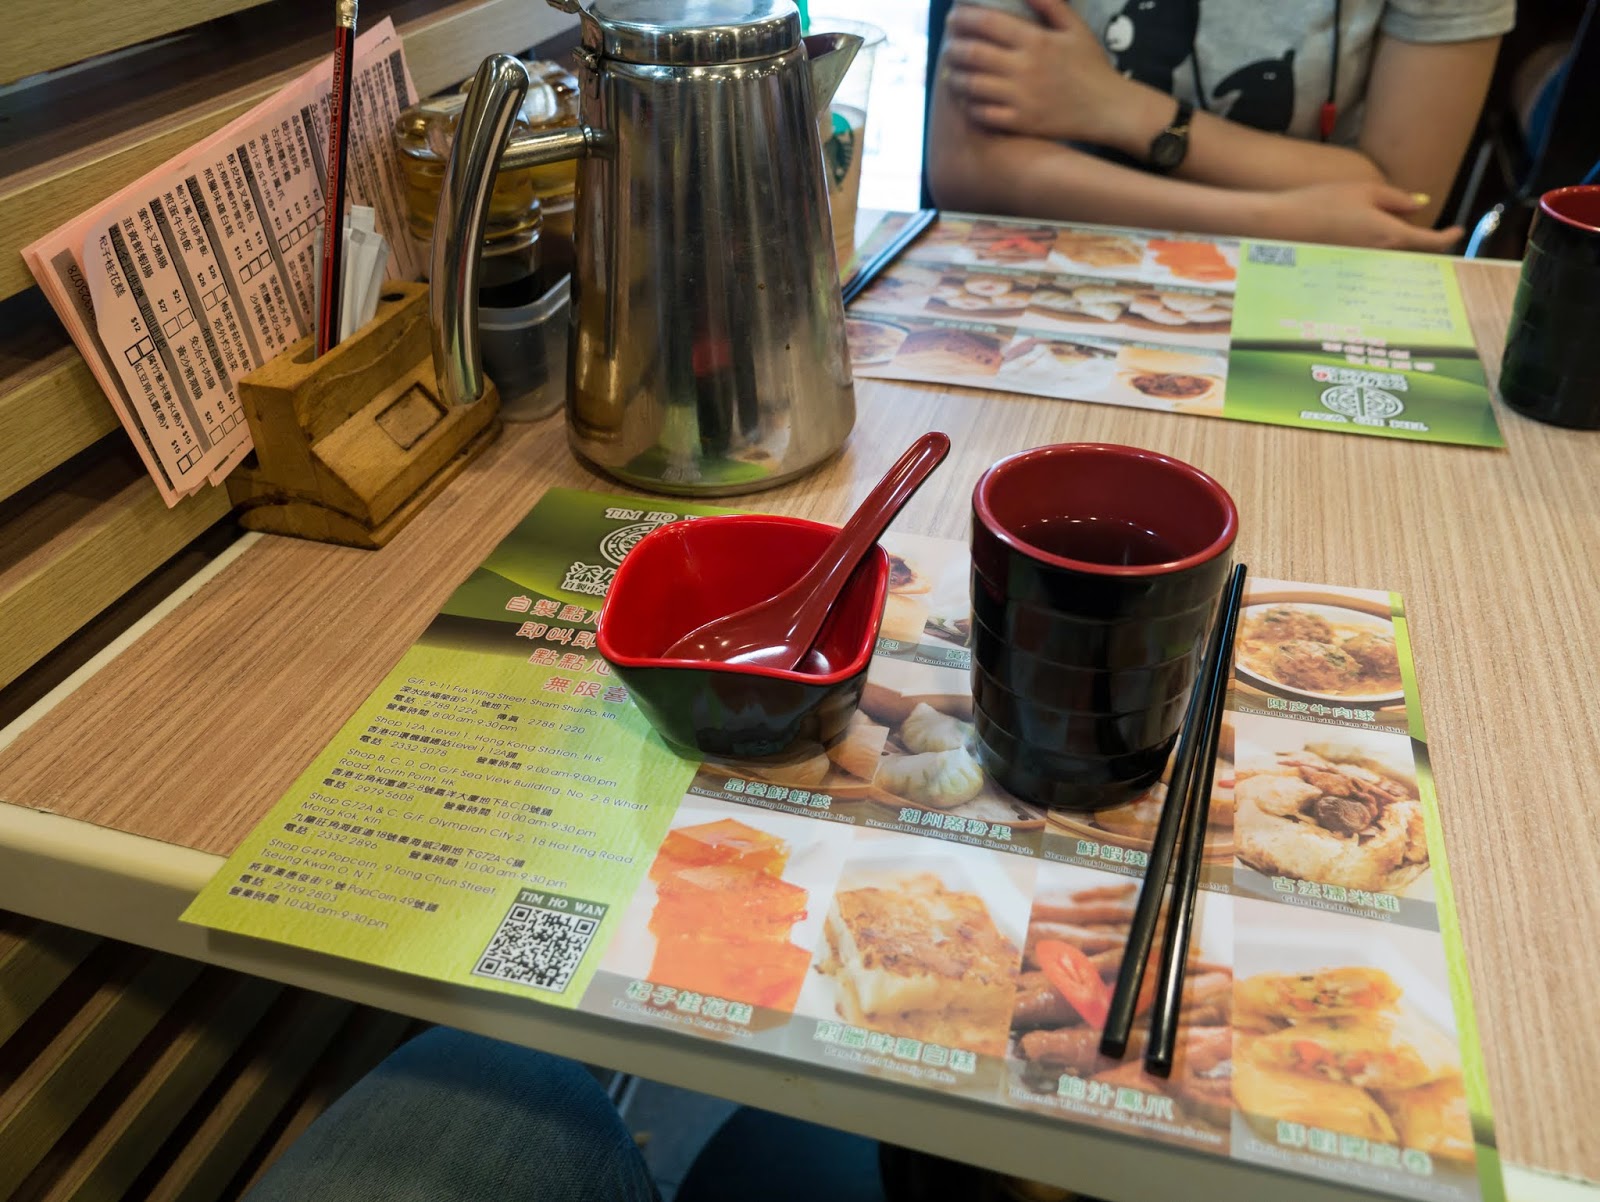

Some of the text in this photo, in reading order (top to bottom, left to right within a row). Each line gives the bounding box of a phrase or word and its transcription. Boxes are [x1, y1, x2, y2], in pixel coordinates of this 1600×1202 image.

[331, 46, 342, 115] CHUNG HWA
[233, 244, 243, 261] $15
[98, 234, 142, 333] 杞子桂花糕 $12
[171, 288, 182, 304] $21
[156, 297, 168, 313] $27
[188, 335, 226, 415] 免治牛肉腸 $21
[226, 390, 237, 405] $21
[203, 410, 214, 425] $21
[170, 438, 181, 455] $15
[181, 429, 192, 445] $15
[605, 507, 641, 521] TIM
[644, 507, 678, 523] HO
[516, 621, 597, 648] 即叫即
[452, 685, 469, 693] Fuk
[471, 688, 495, 698] Wing
[529, 698, 559, 708] Sham
[561, 704, 583, 713] Shui
[542, 676, 631, 704] 無限喜
[423, 700, 585, 733] 2788 1226 2788 1220
[1267, 697, 1375, 722] 陳皮牛肉球
[374, 715, 402, 726] Shop
[430, 726, 460, 736] Level
[474, 734, 504, 746] Hong
[506, 740, 535, 752] Kong
[390, 741, 418, 751] 2332
[419, 746, 447, 756] 3078
[347, 748, 375, 759] Shop
[419, 762, 436, 770] On
[460, 769, 482, 779] Sea
[485, 774, 511, 784] View
[374, 765, 405, 776] North
[440, 777, 453, 786] HK
[354, 784, 384, 795] 2979
[384, 790, 414, 801] 5608
[724, 778, 832, 810] 晶瑩鮮蝦餃
[301, 801, 335, 816] Mong
[309, 792, 339, 804] Shop
[428, 816, 486, 833] Olympian
[489, 828, 513, 840] City
[532, 836, 546, 845] 18
[899, 808, 1012, 841] 潮州蒸粉果
[316, 830, 347, 842] 2332
[348, 836, 377, 849] 2896
[260, 848, 301, 865] Tseung
[302, 858, 335, 871] Kwan
[268, 838, 298, 851] Shop
[301, 845, 327, 856] G49
[384, 863, 392, 871] 9
[393, 865, 422, 880] Tong
[424, 873, 457, 886] Chun
[273, 881, 338, 902] 2789 2803
[521, 891, 605, 917] TIM HO WAN
[1271, 876, 1400, 912] 古法糯米雞
